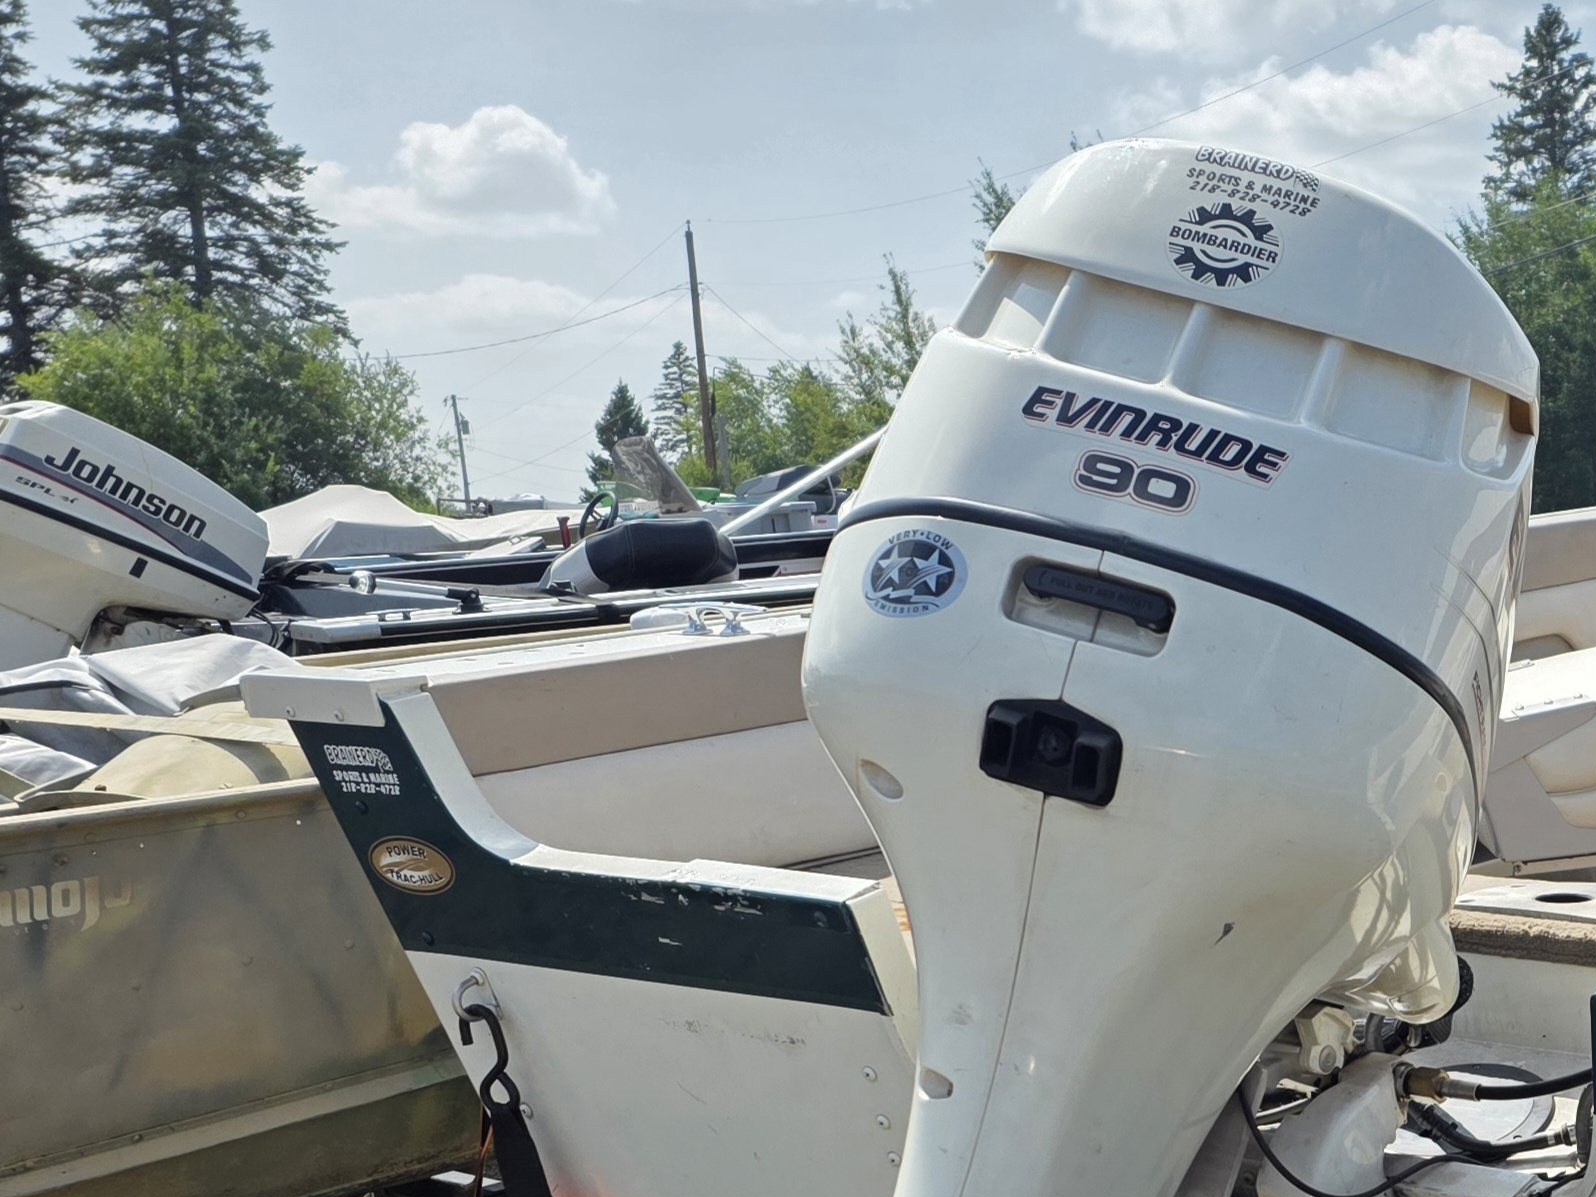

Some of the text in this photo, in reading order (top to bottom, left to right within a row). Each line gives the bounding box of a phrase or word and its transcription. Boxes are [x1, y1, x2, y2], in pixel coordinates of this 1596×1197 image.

[1195, 146, 1295, 181] BRAINERD
[1187, 168, 1321, 208] SPORTS & MARINE
[1189, 181, 1312, 217] 218-828-4728
[1169, 225, 1279, 264] BOMBARDIER
[1021, 386, 1289, 483] EVINRUDE
[44, 447, 207, 540] Johnson
[1076, 451, 1194, 511] 90
[888, 529, 953, 551] VERY LOW
[874, 600, 929, 614] EMISSION
[324, 744, 377, 767] BRAINERD
[333, 770, 361, 782] SPORTS
[369, 772, 400, 785] MARINE
[341, 782, 400, 795] 218-828-4728
[386, 845, 427, 859] POWER
[389, 868, 444, 885] TRAC-HULL
